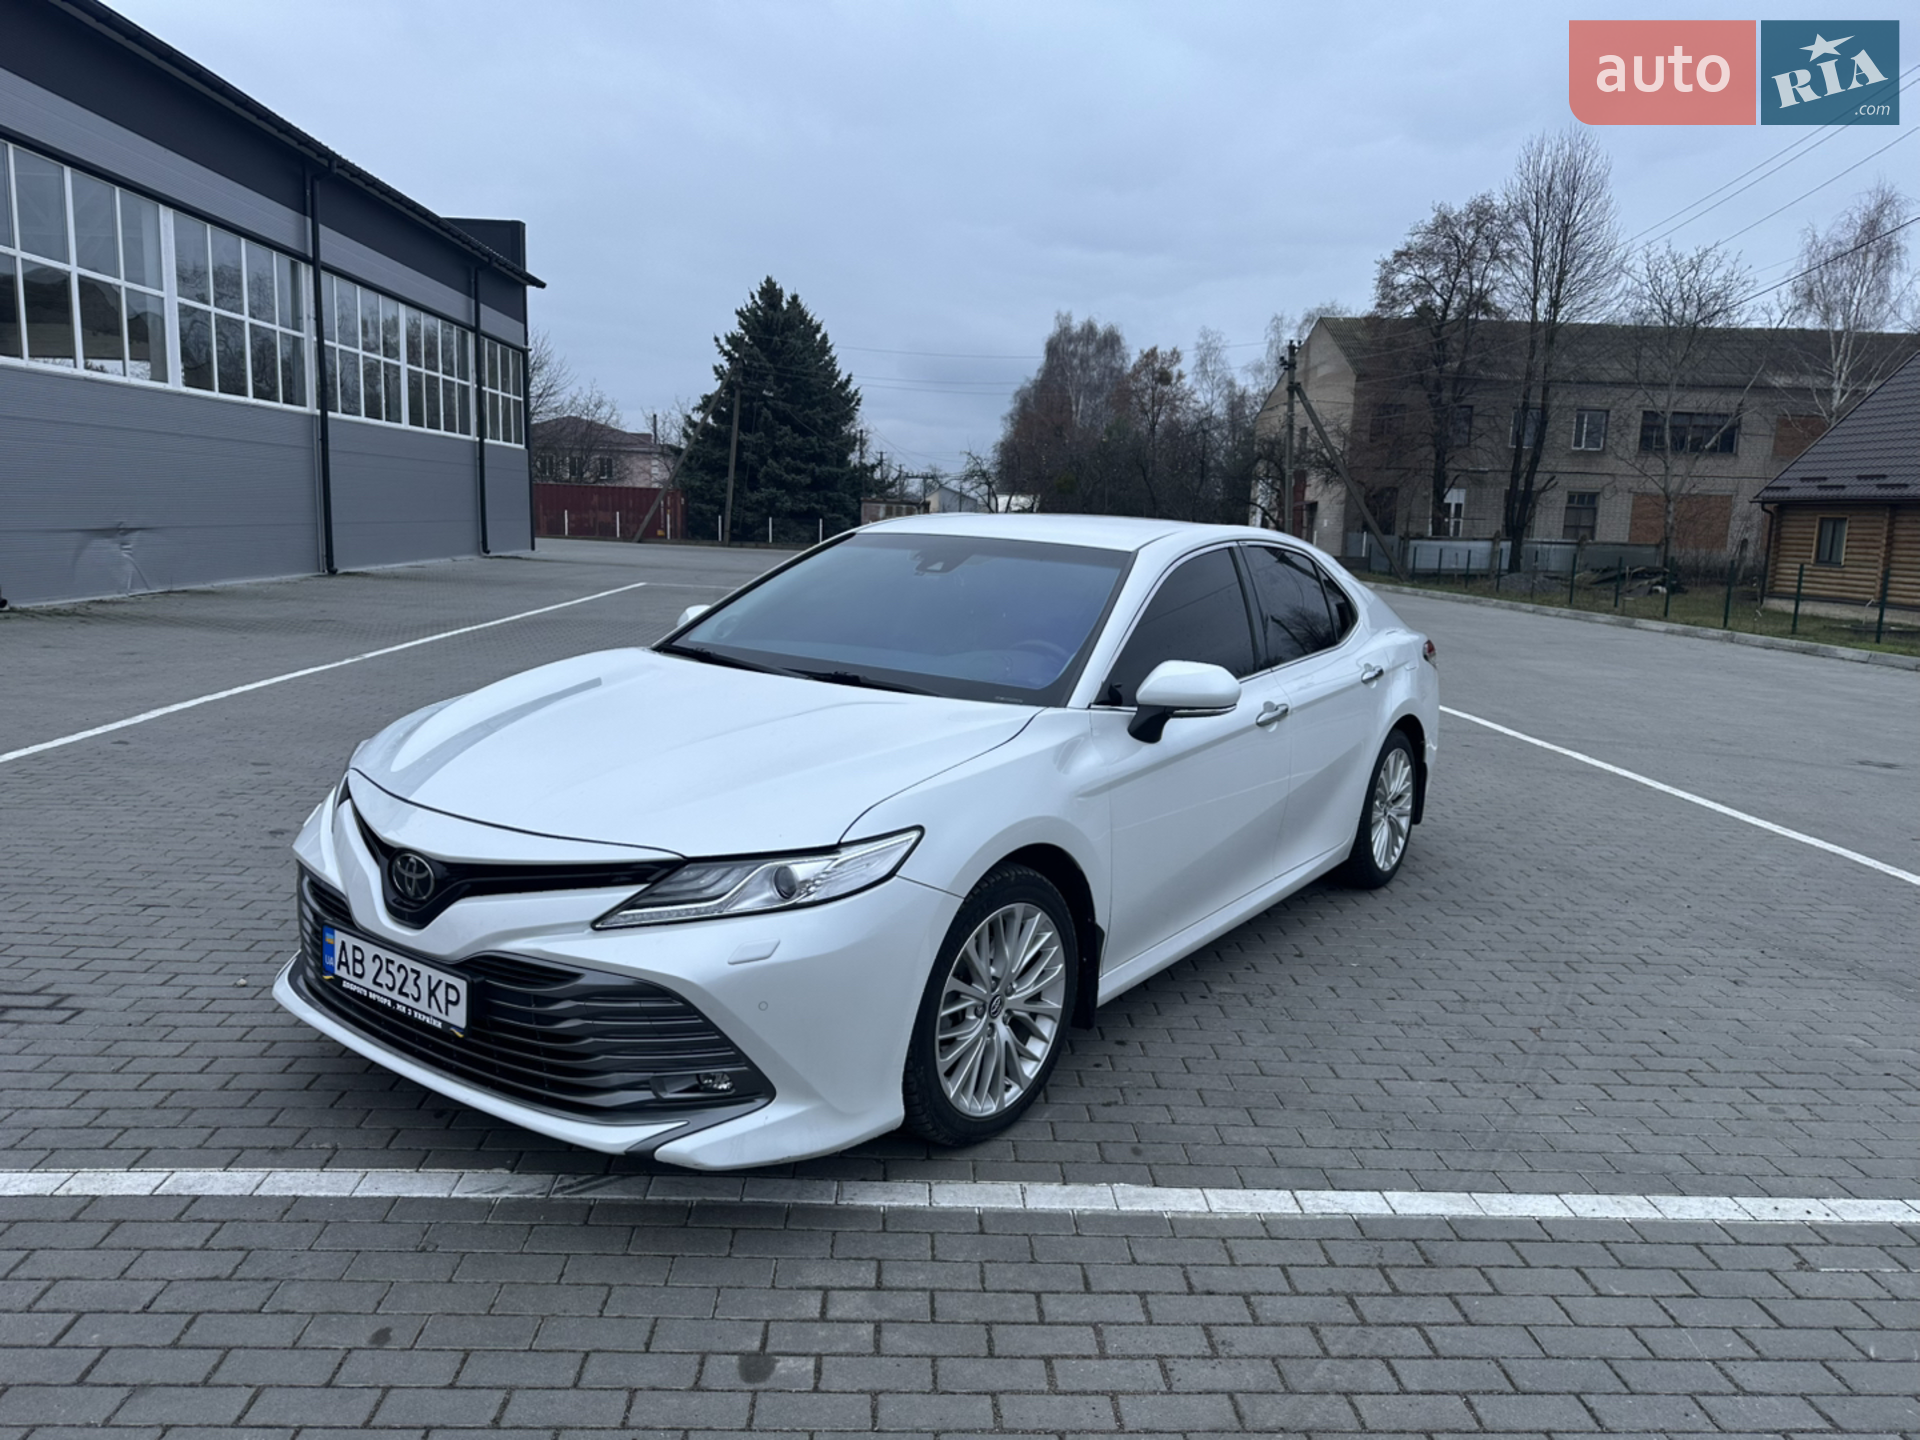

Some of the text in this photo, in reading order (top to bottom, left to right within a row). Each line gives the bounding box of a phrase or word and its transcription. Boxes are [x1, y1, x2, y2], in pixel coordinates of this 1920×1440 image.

[336, 940, 461, 1017] AB 2523 KP
